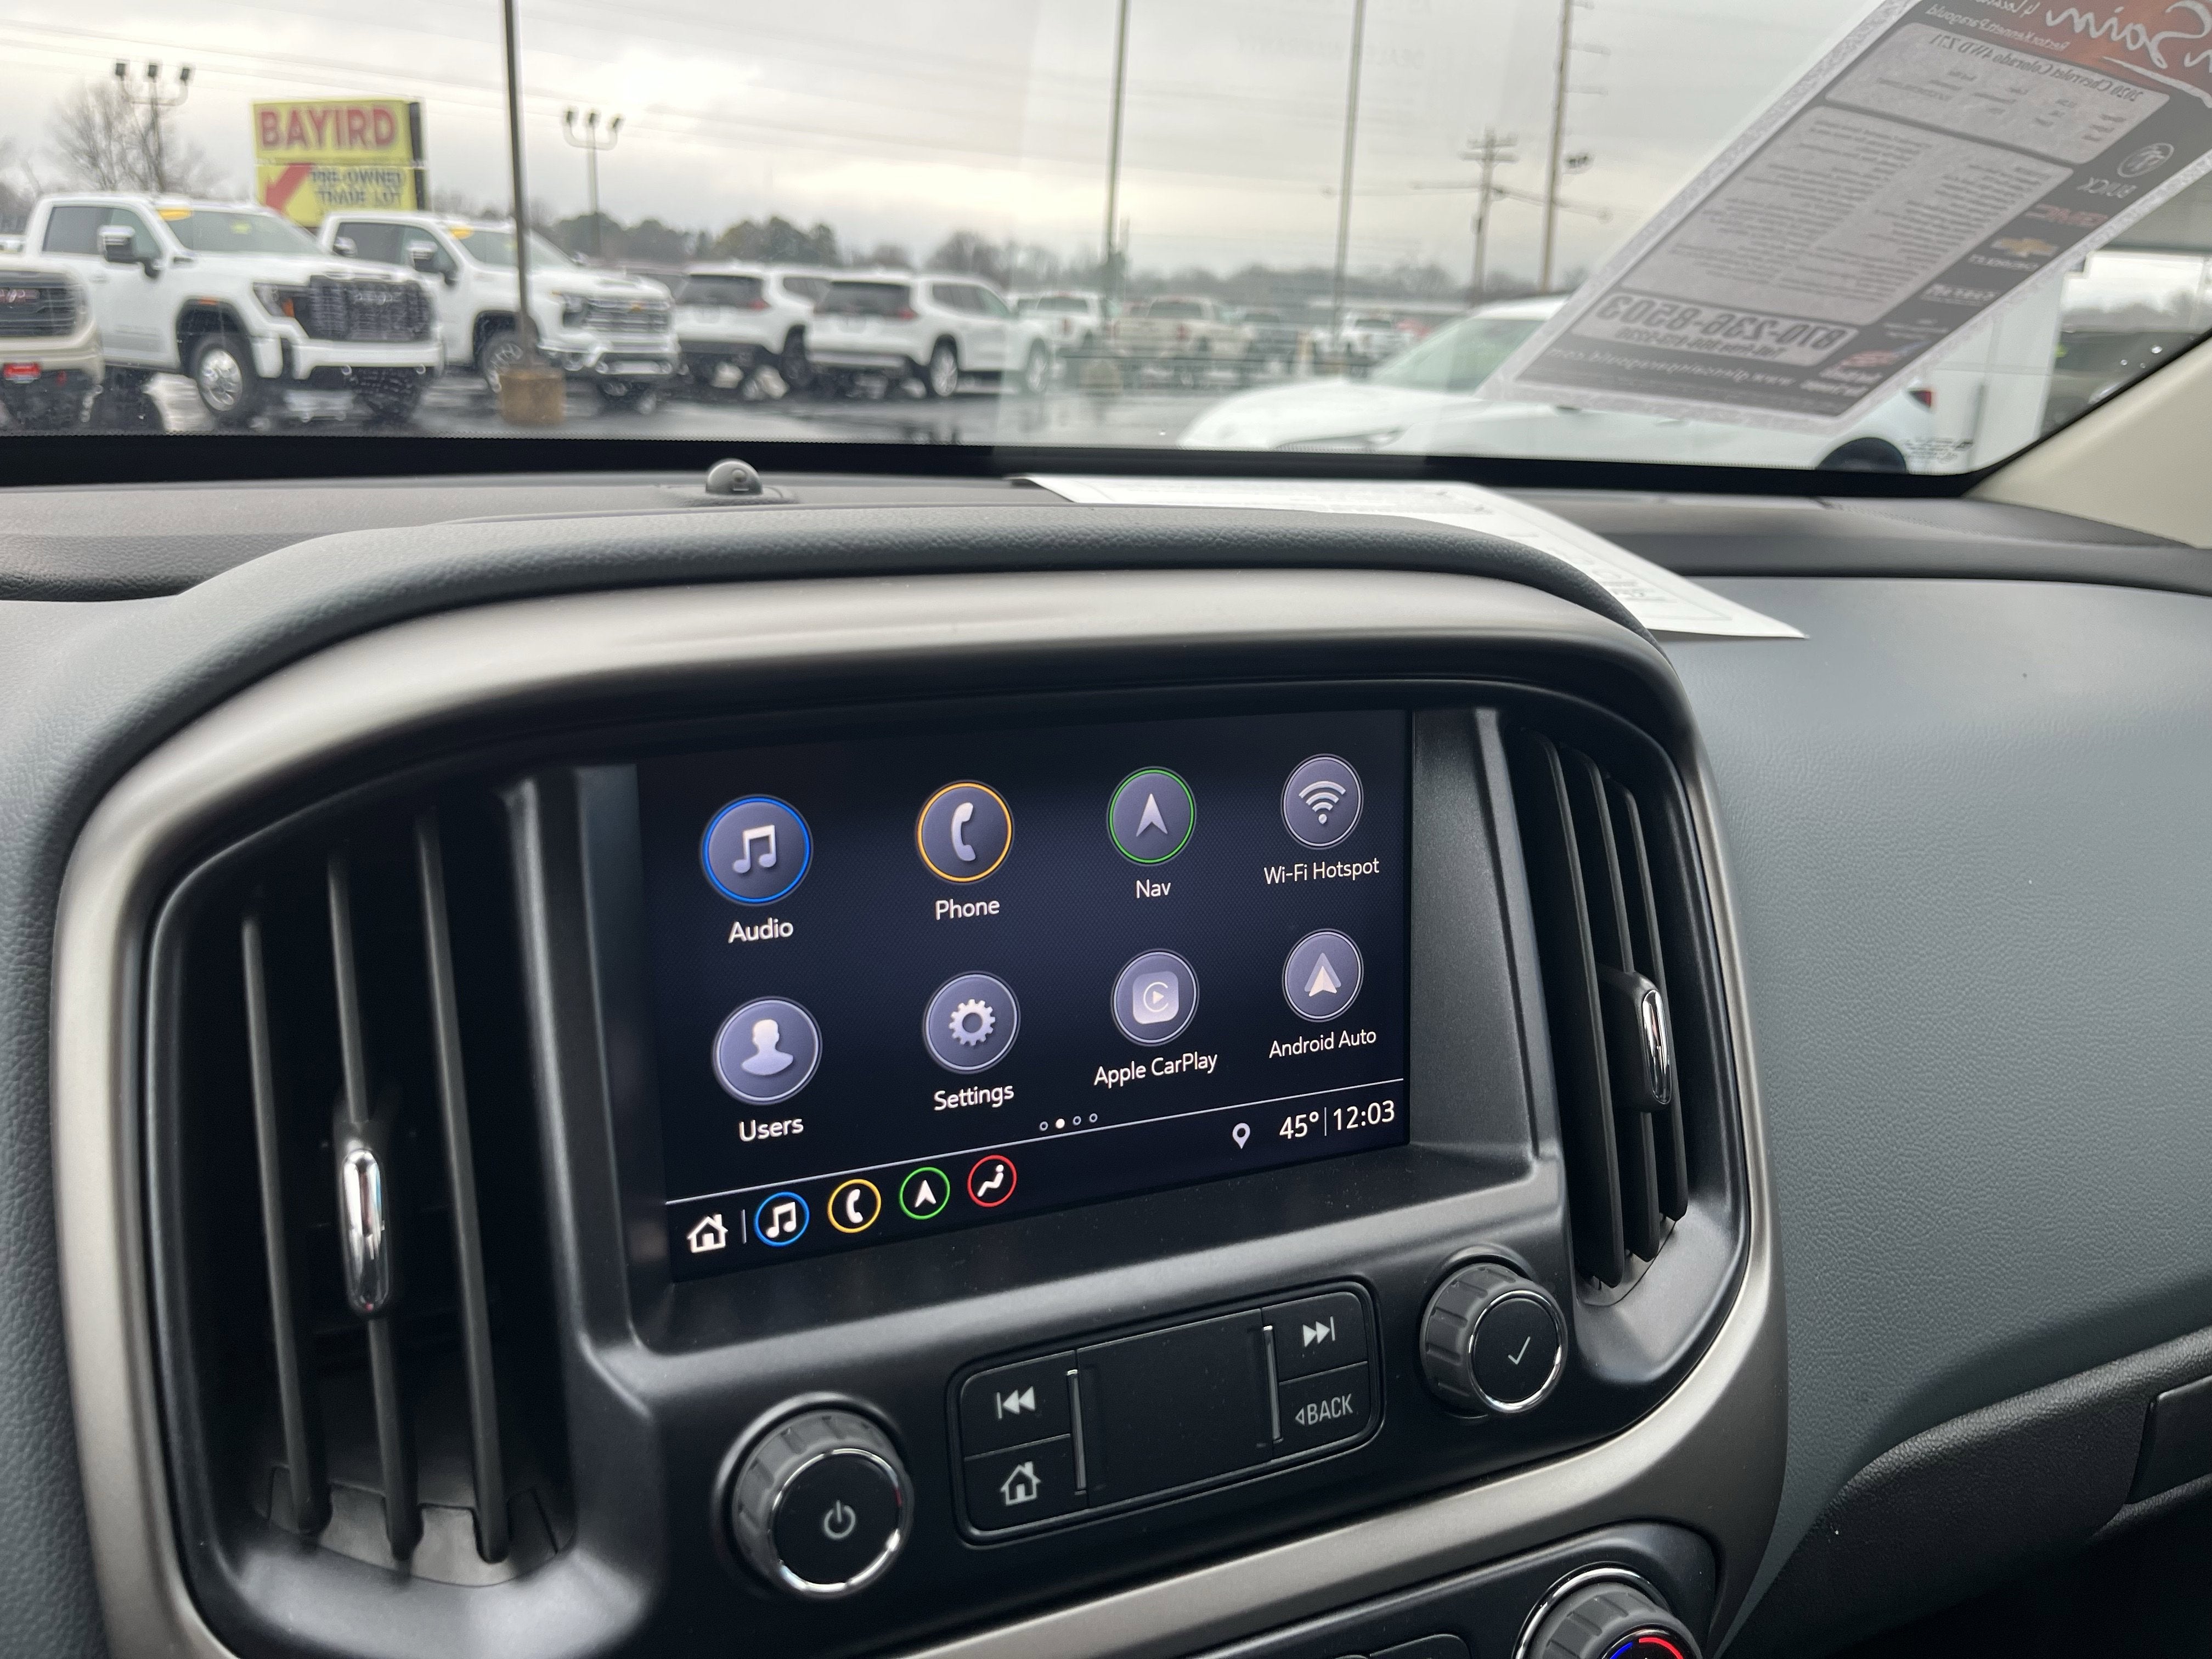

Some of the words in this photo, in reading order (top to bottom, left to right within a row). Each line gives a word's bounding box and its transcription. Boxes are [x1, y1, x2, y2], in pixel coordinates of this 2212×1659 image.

[260, 108, 396, 150] BAYIRD
[1264, 864, 1307, 884] Wi-Fi
[1313, 858, 1379, 881] Hotspot
[1137, 879, 1171, 898] Nav
[935, 899, 1000, 920] Phone
[729, 917, 793, 943] Audio
[1269, 1032, 1334, 1058] Android
[1339, 1029, 1376, 1048] Auto
[1094, 1061, 1146, 1088] Apple
[1152, 1052, 1217, 1075] CarPlay
[934, 1086, 1014, 1110] Settings
[740, 1119, 803, 1141] Users
[1279, 1111, 1319, 1139] 45°
[1334, 1101, 1394, 1130] 12:03
[1307, 1394, 1352, 1424] BACK
